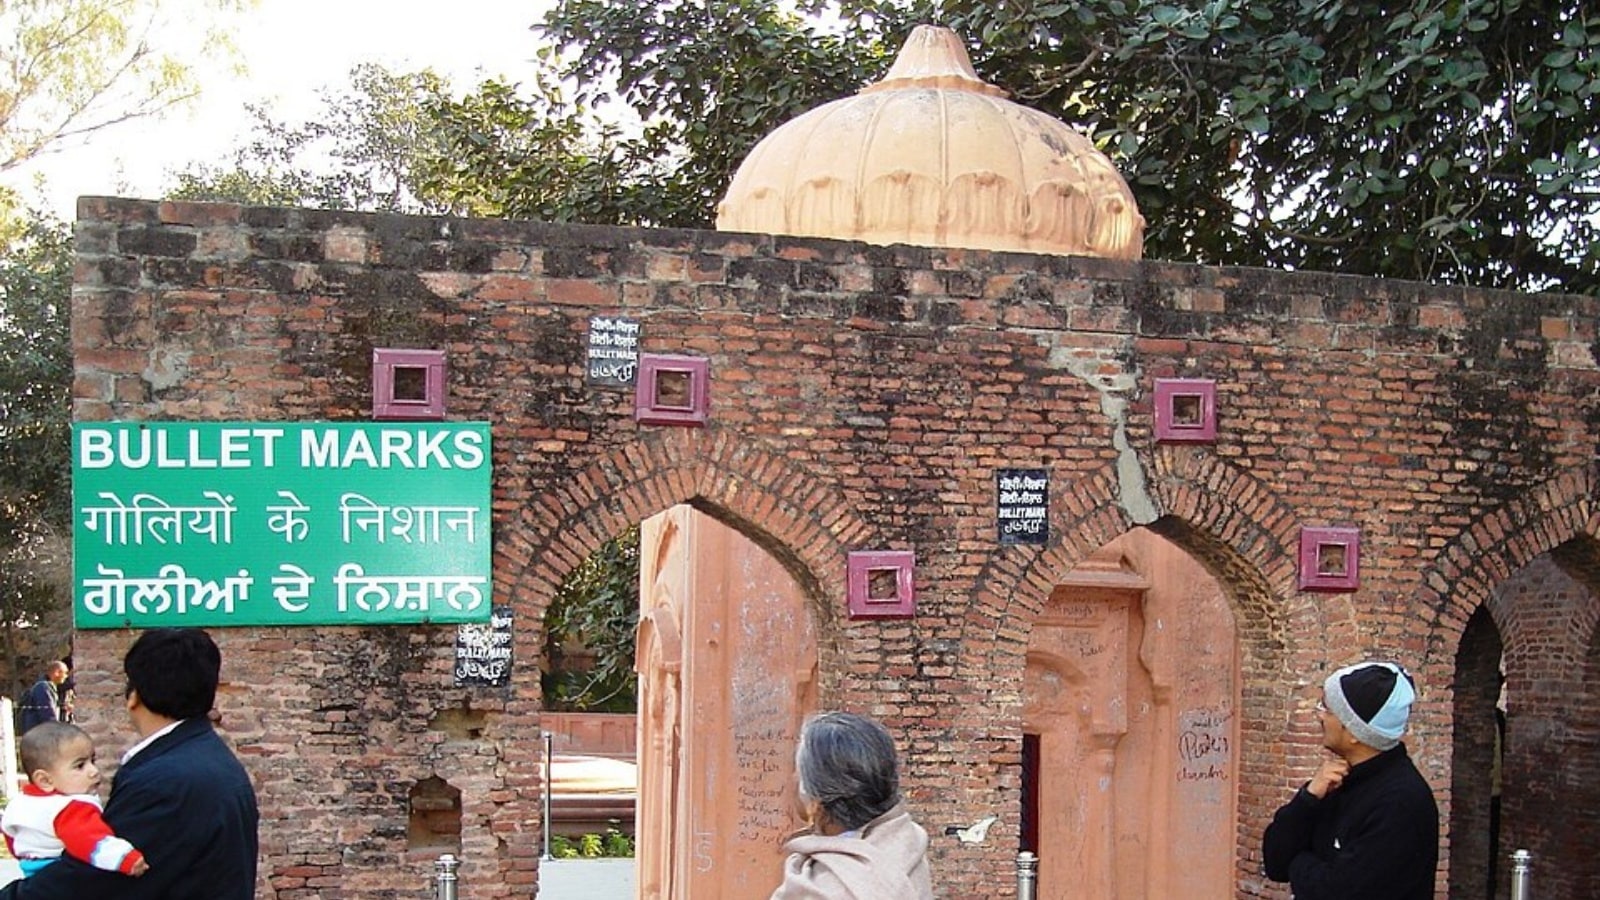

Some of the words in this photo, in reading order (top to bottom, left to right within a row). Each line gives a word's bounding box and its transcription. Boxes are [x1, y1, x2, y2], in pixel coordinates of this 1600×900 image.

[80, 428, 284, 469] BULLET
[301, 430, 484, 469] MARKS
[81, 491, 237, 545] गोलियों
[265, 490, 311, 544] के
[339, 492, 480, 544] निशान
[83, 563, 254, 615] ਗੋਲੀਆਂ
[271, 564, 316, 612] ਦੇ
[333, 563, 487, 612] ਨਿਸ਼ਾਨ
